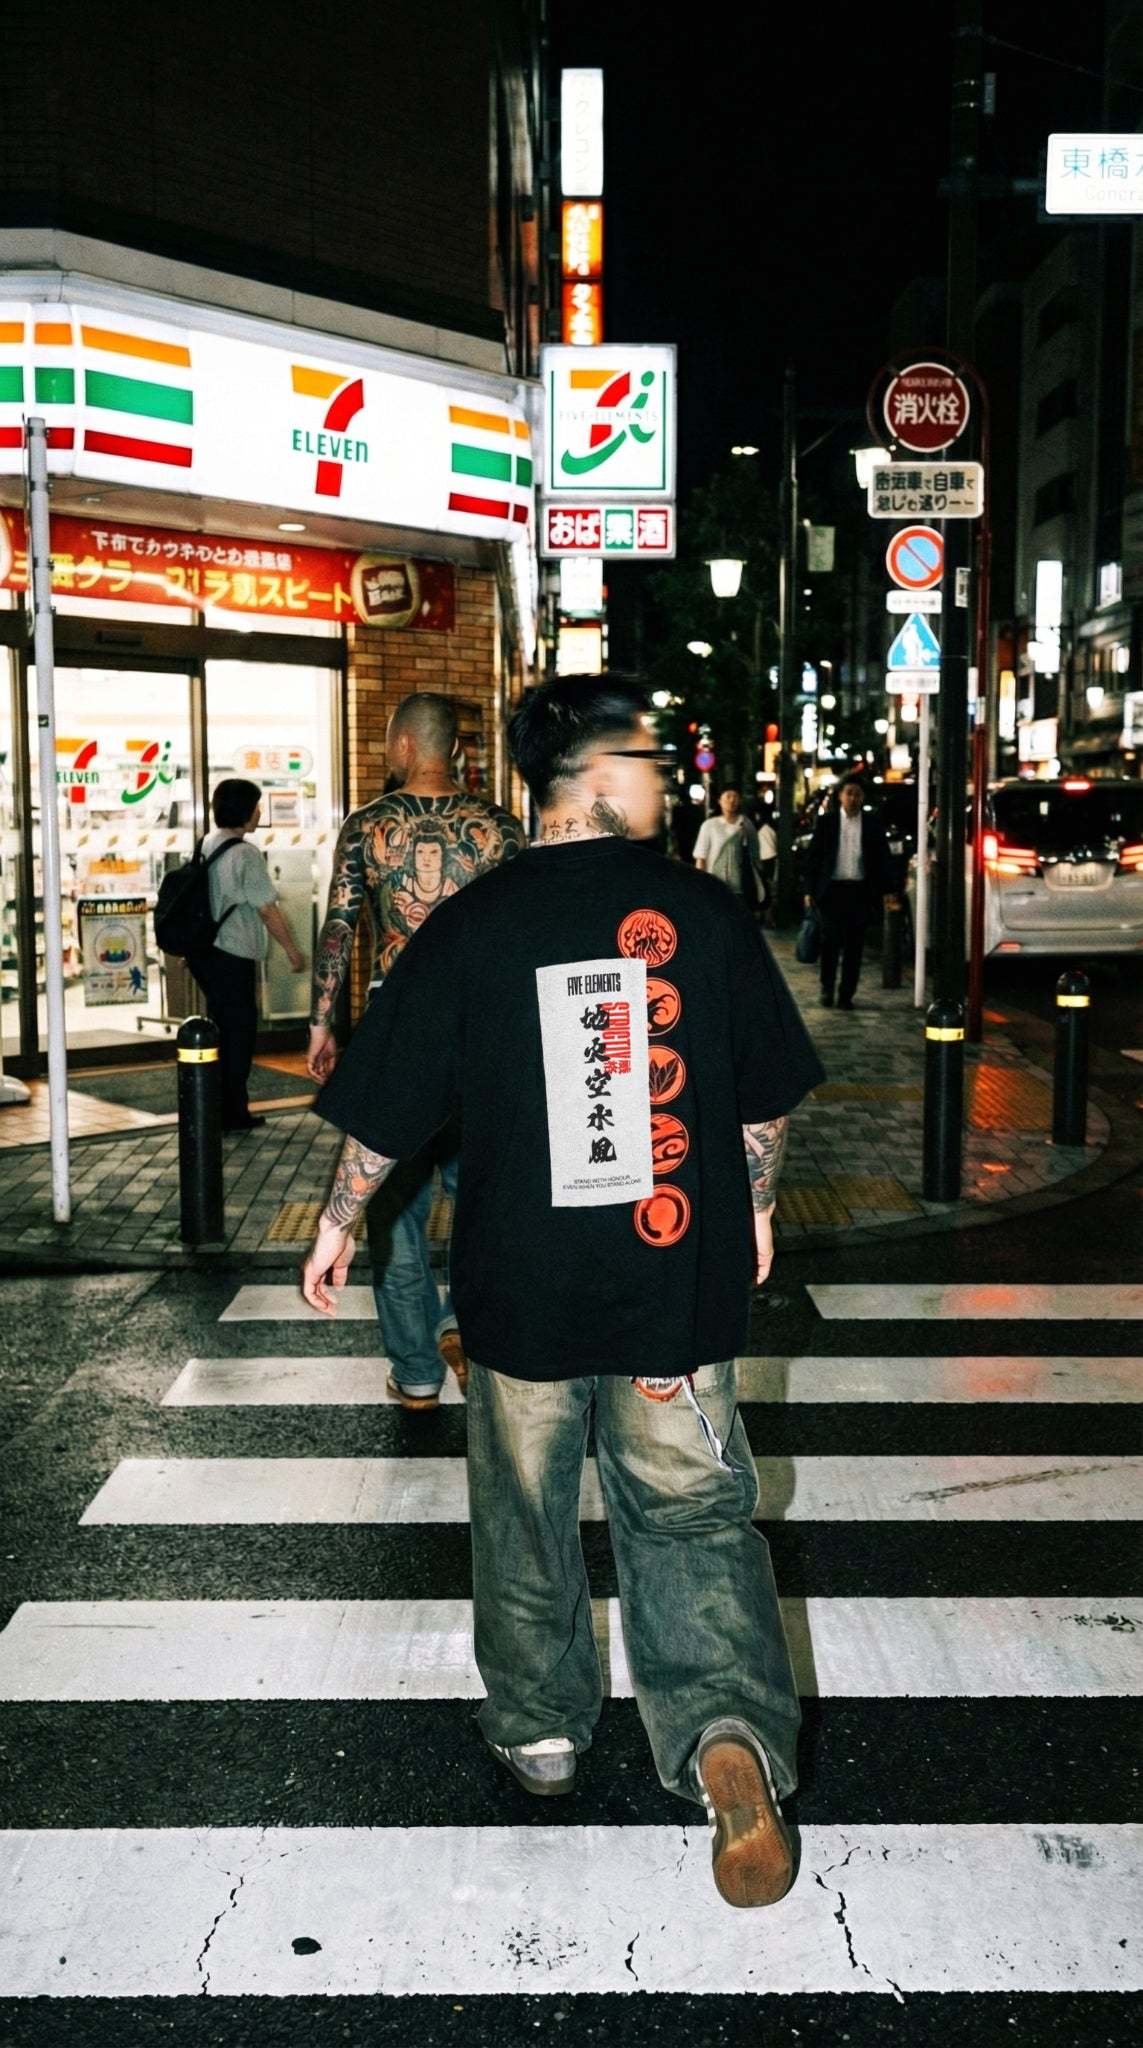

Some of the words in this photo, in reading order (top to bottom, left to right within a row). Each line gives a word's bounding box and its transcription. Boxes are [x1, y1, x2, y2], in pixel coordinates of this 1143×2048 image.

[894, 393, 960, 425] 消火栓
[567, 976, 583, 996] FIVE
[585, 973, 621, 994] ELEMENTS
